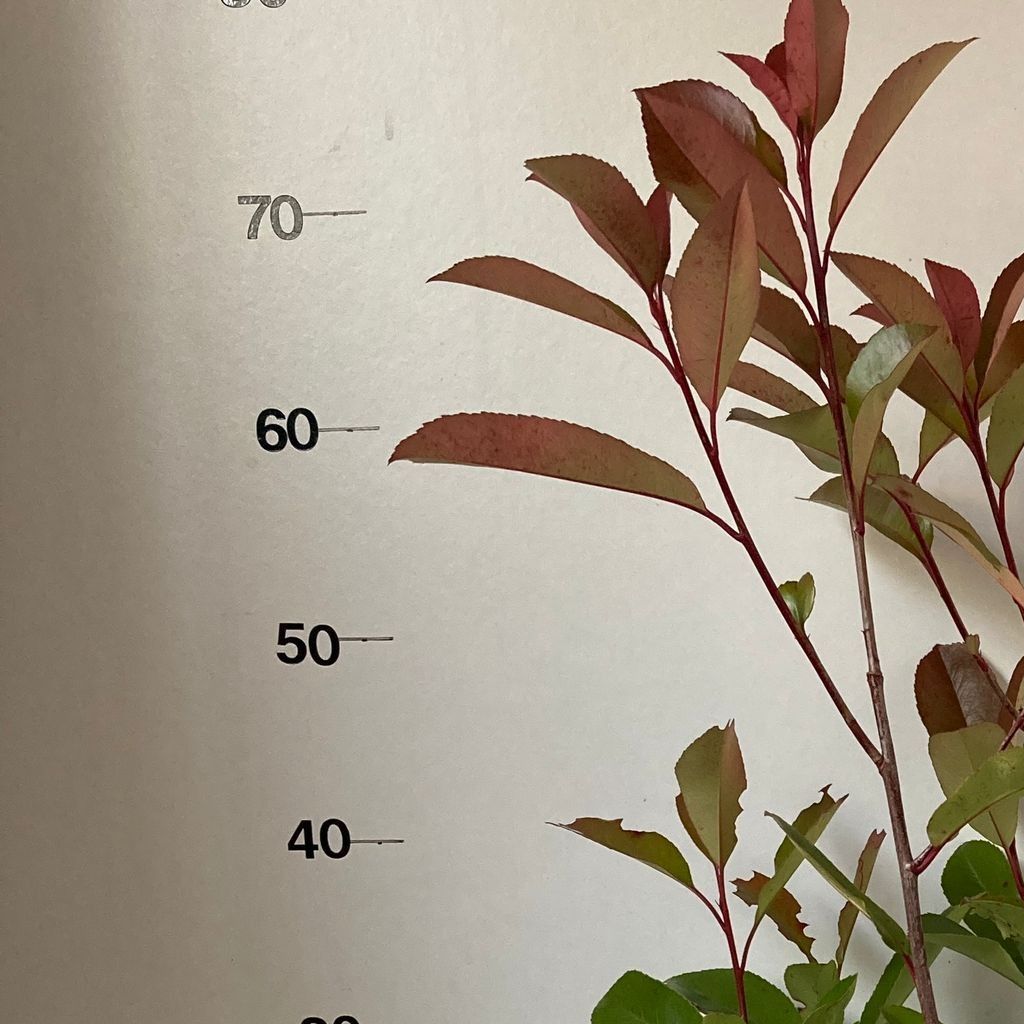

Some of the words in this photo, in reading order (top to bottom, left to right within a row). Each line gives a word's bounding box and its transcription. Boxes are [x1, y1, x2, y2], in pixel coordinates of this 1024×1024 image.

[237, 194, 304, 241] 70
[256, 407, 319, 453] 60
[276, 622, 340, 667] 50
[287, 818, 351, 860] 40
